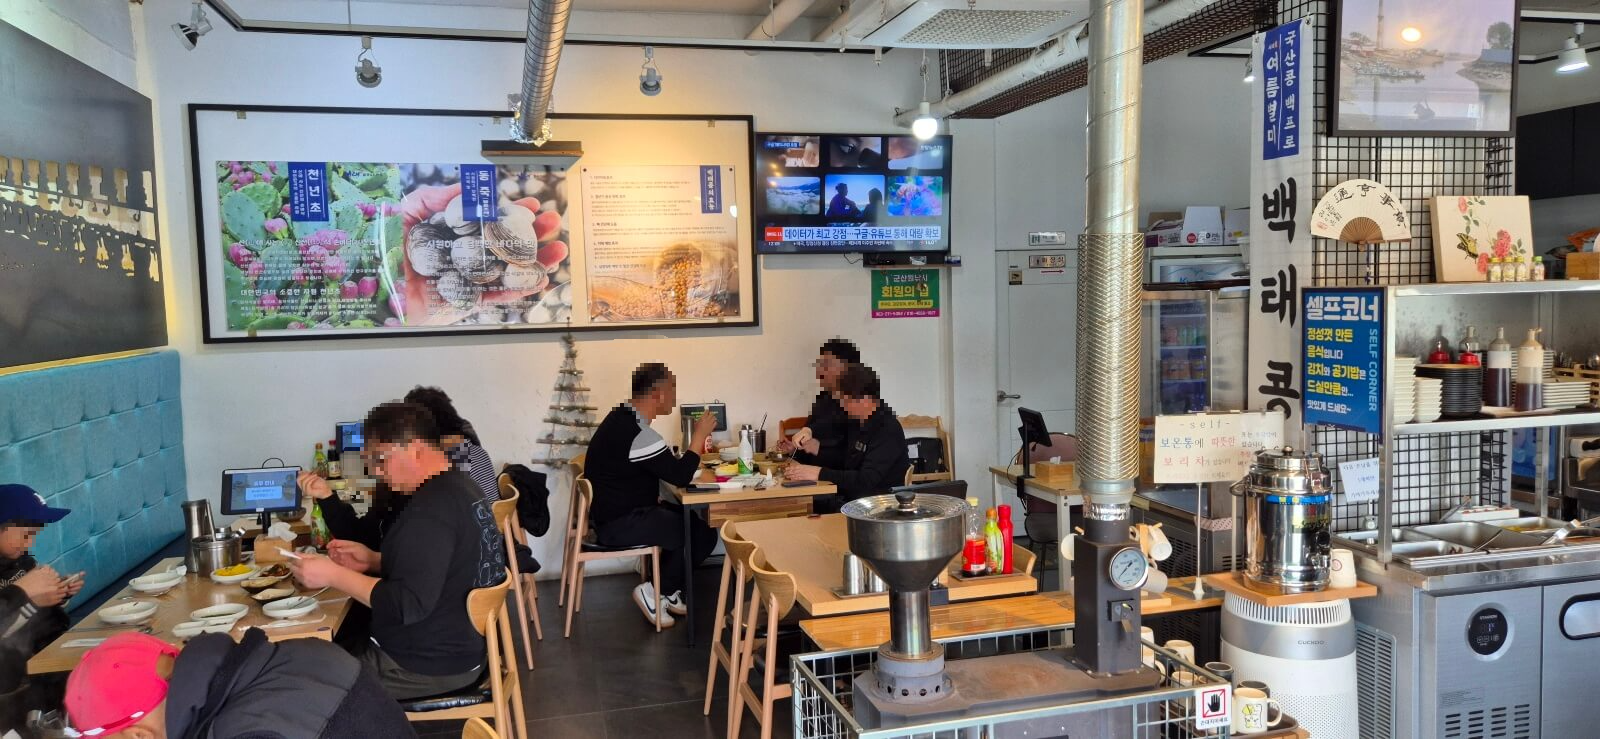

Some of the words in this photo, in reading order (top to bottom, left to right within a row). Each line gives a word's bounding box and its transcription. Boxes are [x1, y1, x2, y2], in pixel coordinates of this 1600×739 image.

[1284, 30, 1297, 87] 국산콩
[1265, 51, 1280, 145] 여름별미
[1283, 94, 1297, 149] 백프로
[307, 168, 323, 213] 천년초
[425, 240, 464, 249] 시원하고
[785, 228, 814, 240] 데이터가
[816, 228, 830, 240] 최고
[910, 228, 923, 239] 대량
[925, 228, 939, 239] 확보
[881, 285, 915, 297] 회원의
[1258, 176, 1300, 421] 백태콩
[1306, 295, 1379, 322] 셀프코너
[1307, 327, 1333, 342] 정성껏
[1335, 328, 1353, 343] 만든
[1369, 328, 1378, 359] SELF
[1307, 345, 1344, 360] 음식입니다
[1307, 362, 1331, 377] 김치와
[1332, 364, 1367, 380] 공기밥은
[1368, 361, 1378, 412] CORNER
[1307, 399, 1327, 412] 맛있게
[1160, 436, 1204, 449] 보온통에
[1211, 436, 1235, 447] 따뜻한
